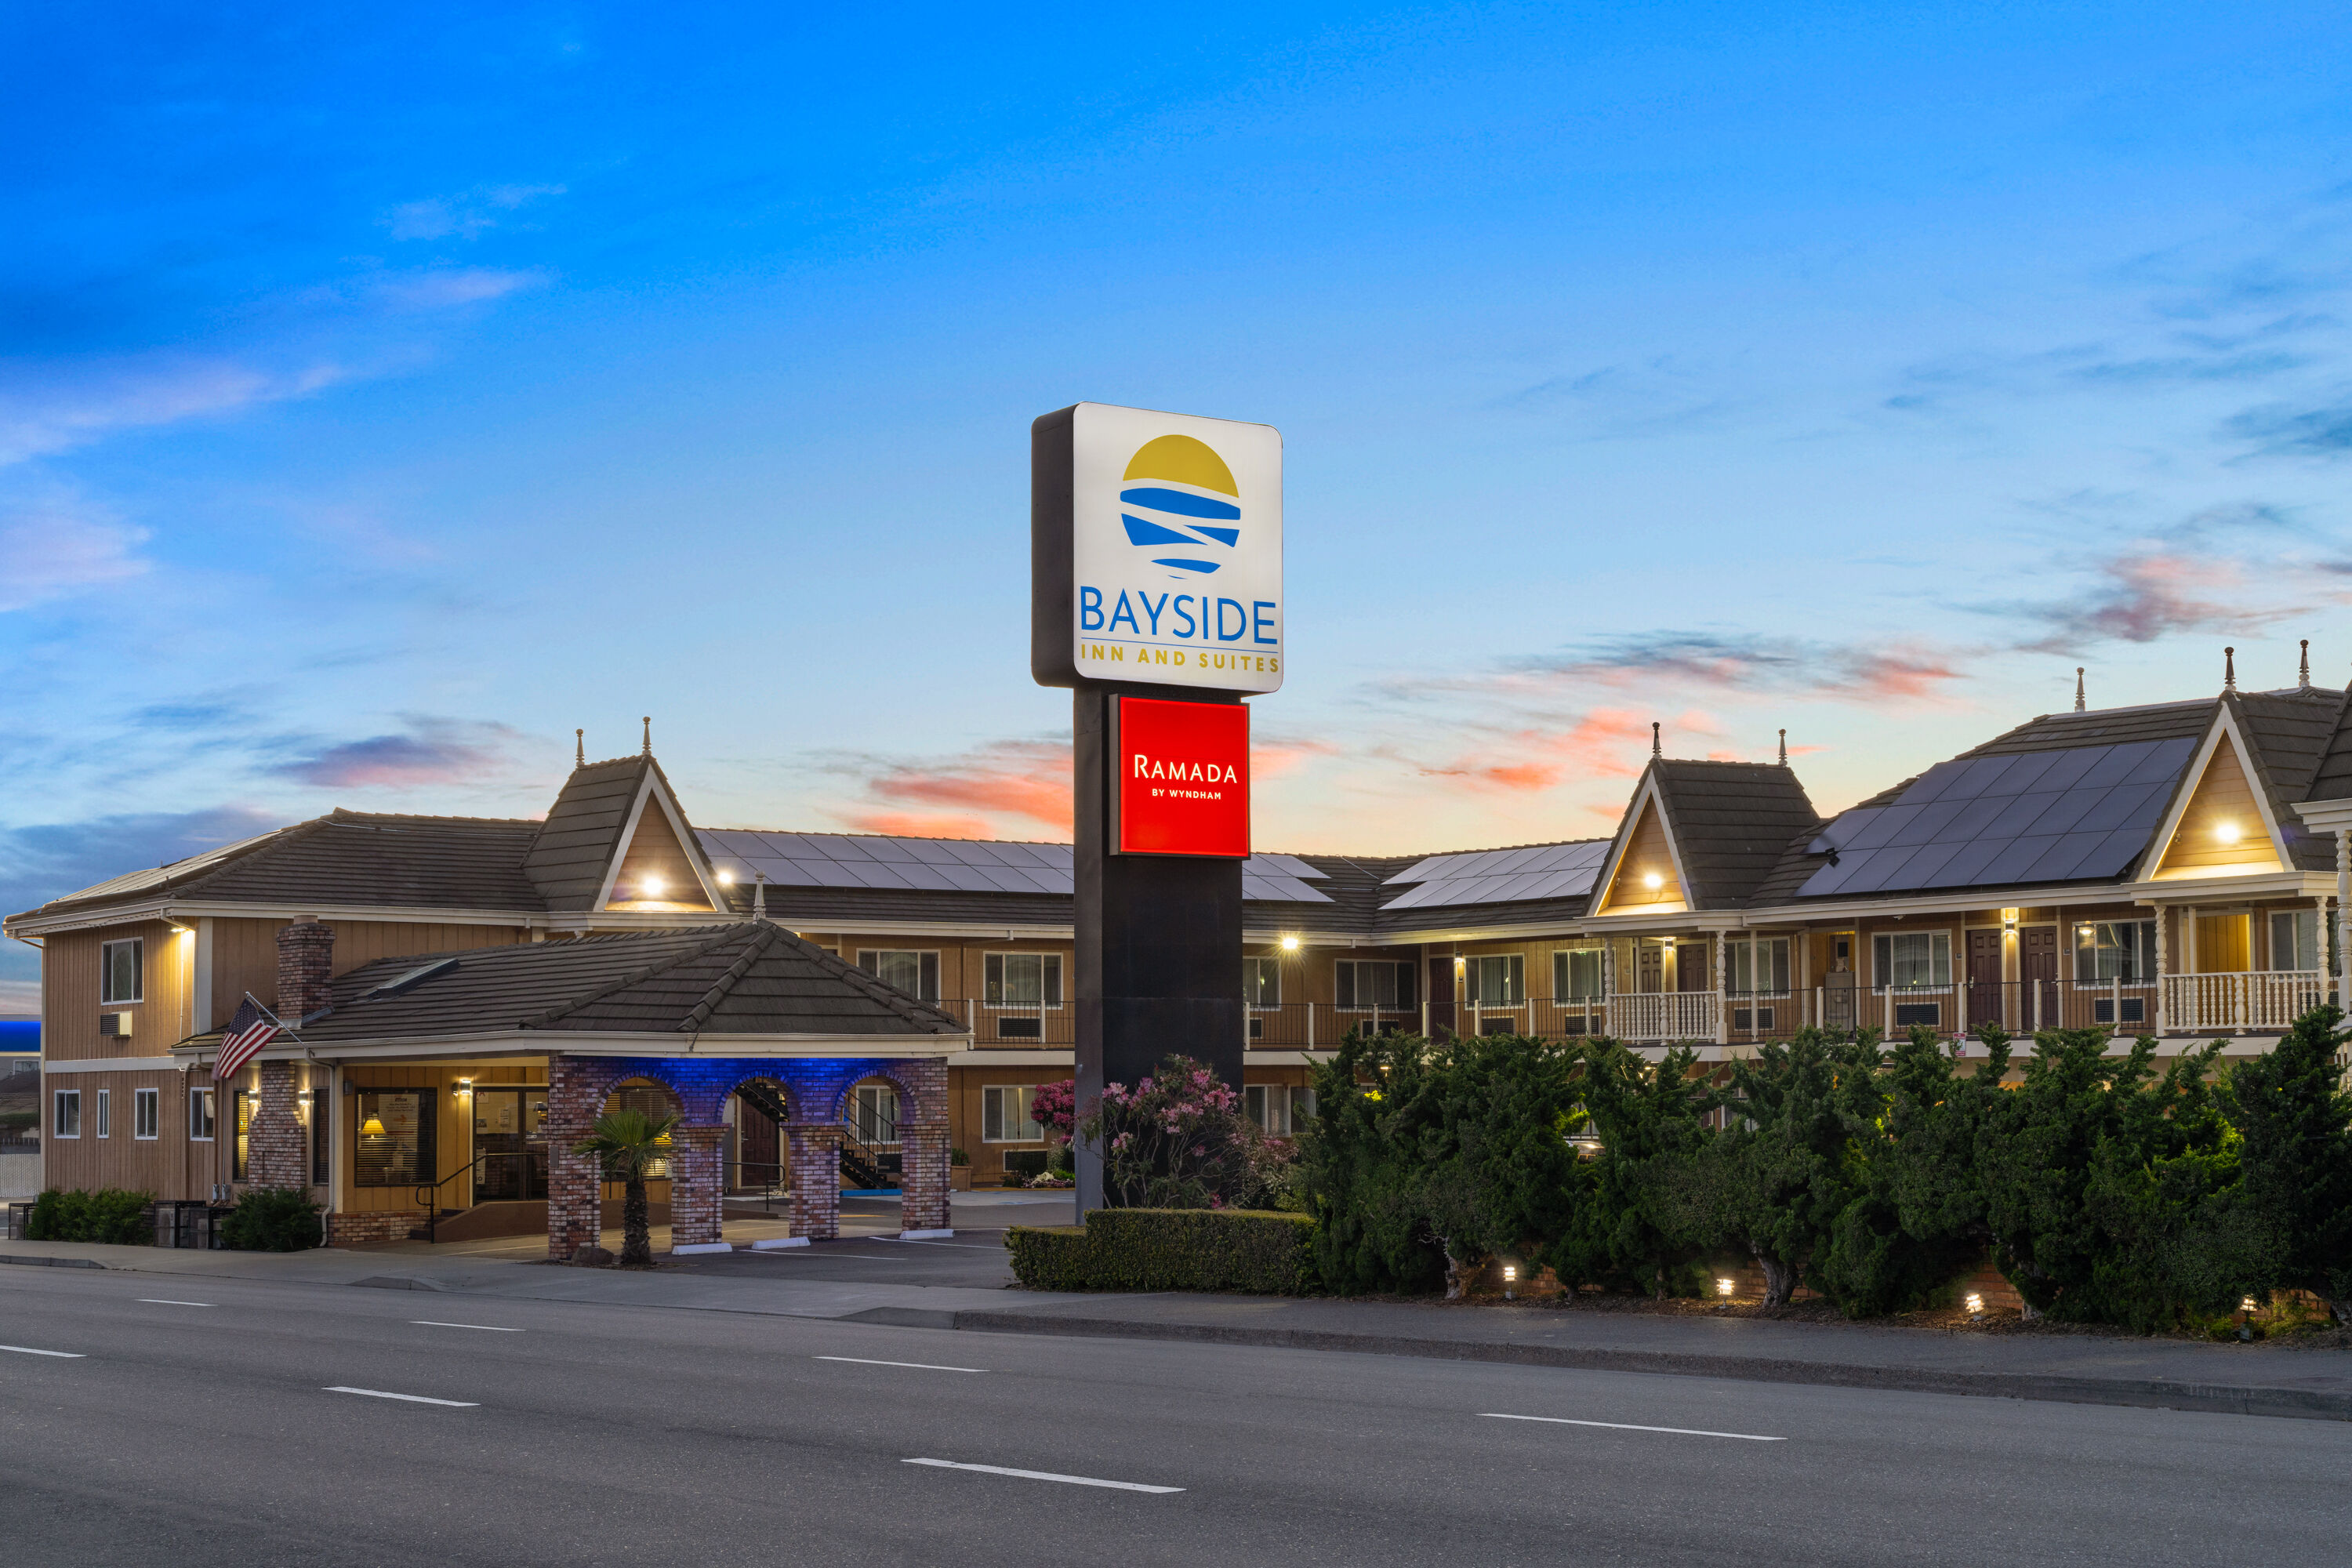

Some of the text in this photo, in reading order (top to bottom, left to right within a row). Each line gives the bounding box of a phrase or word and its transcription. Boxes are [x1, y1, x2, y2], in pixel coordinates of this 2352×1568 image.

[1080, 586, 1278, 645] BAYSIDE
[1081, 644, 1279, 673] INN AND SUITES
[1134, 753, 1238, 784] RAMADA
[1152, 788, 1221, 800] BY WYNDHAM
